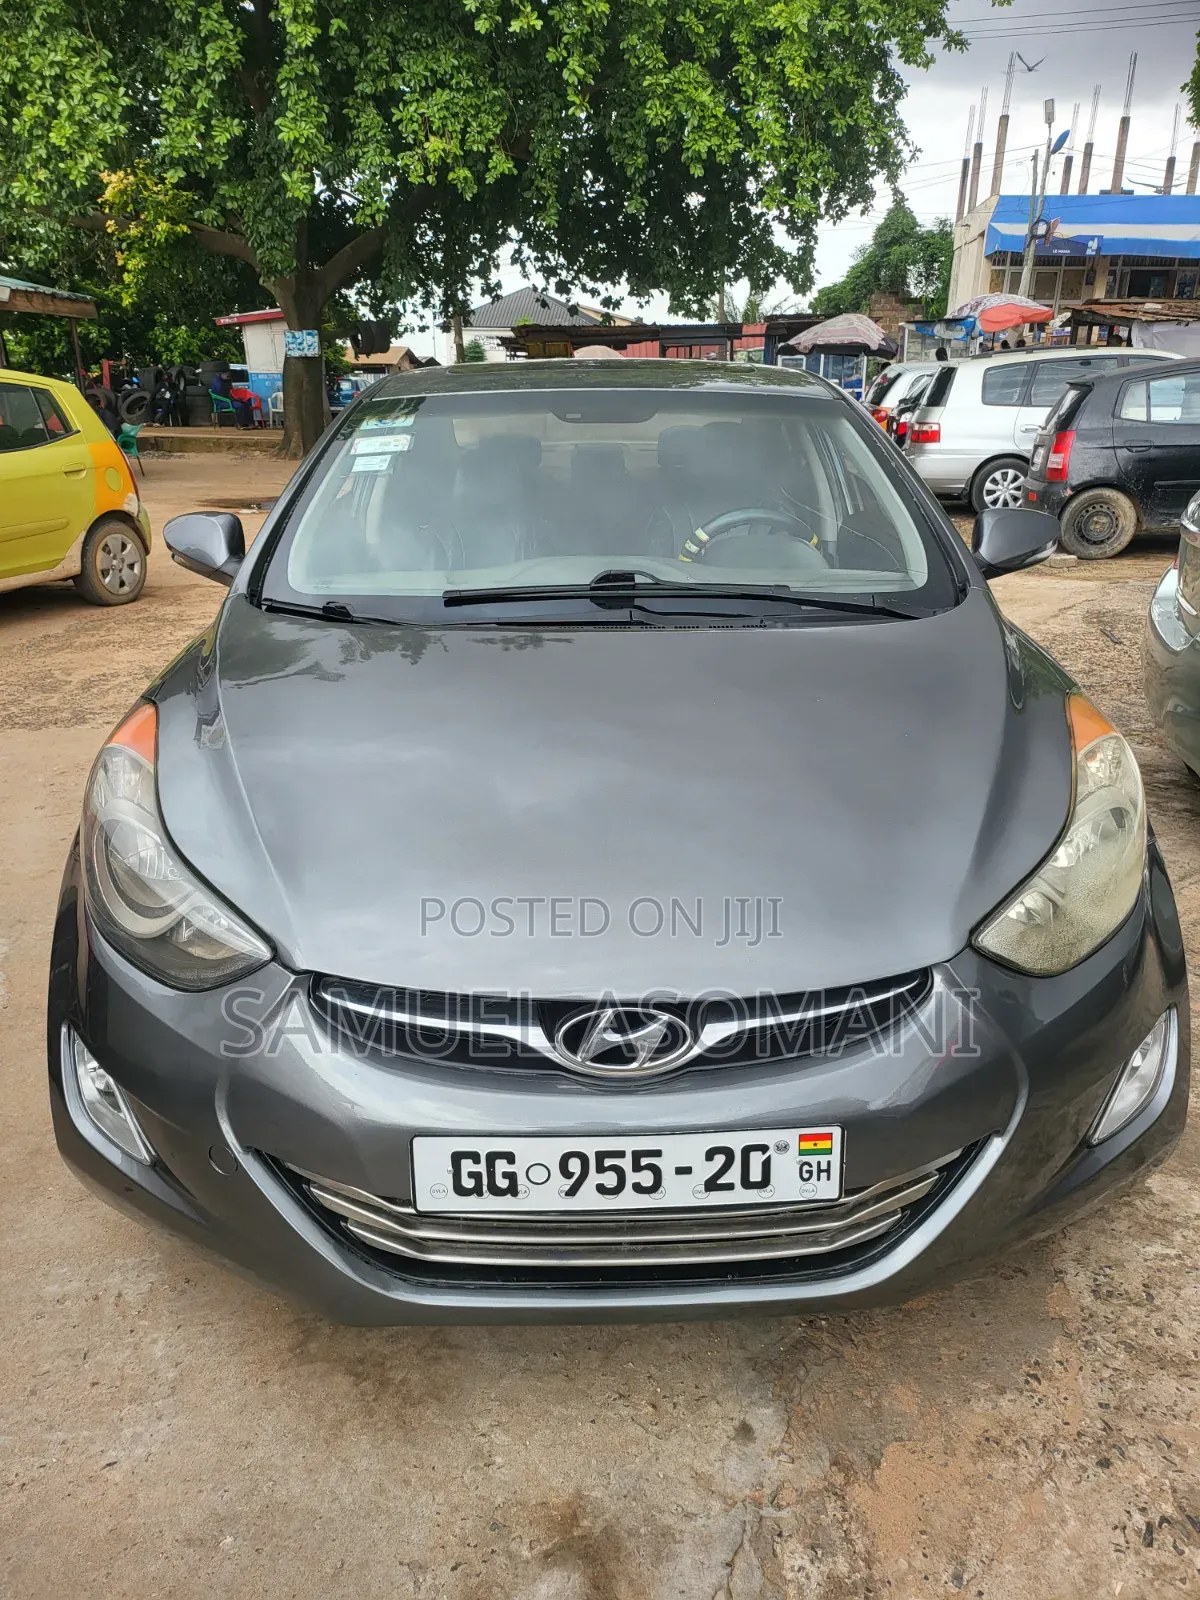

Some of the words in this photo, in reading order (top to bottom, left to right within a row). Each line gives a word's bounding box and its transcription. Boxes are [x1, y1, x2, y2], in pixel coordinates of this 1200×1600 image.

[451, 1150, 519, 1197] GG
[559, 1144, 771, 1197] 955-20
[799, 1160, 831, 1182] GH
